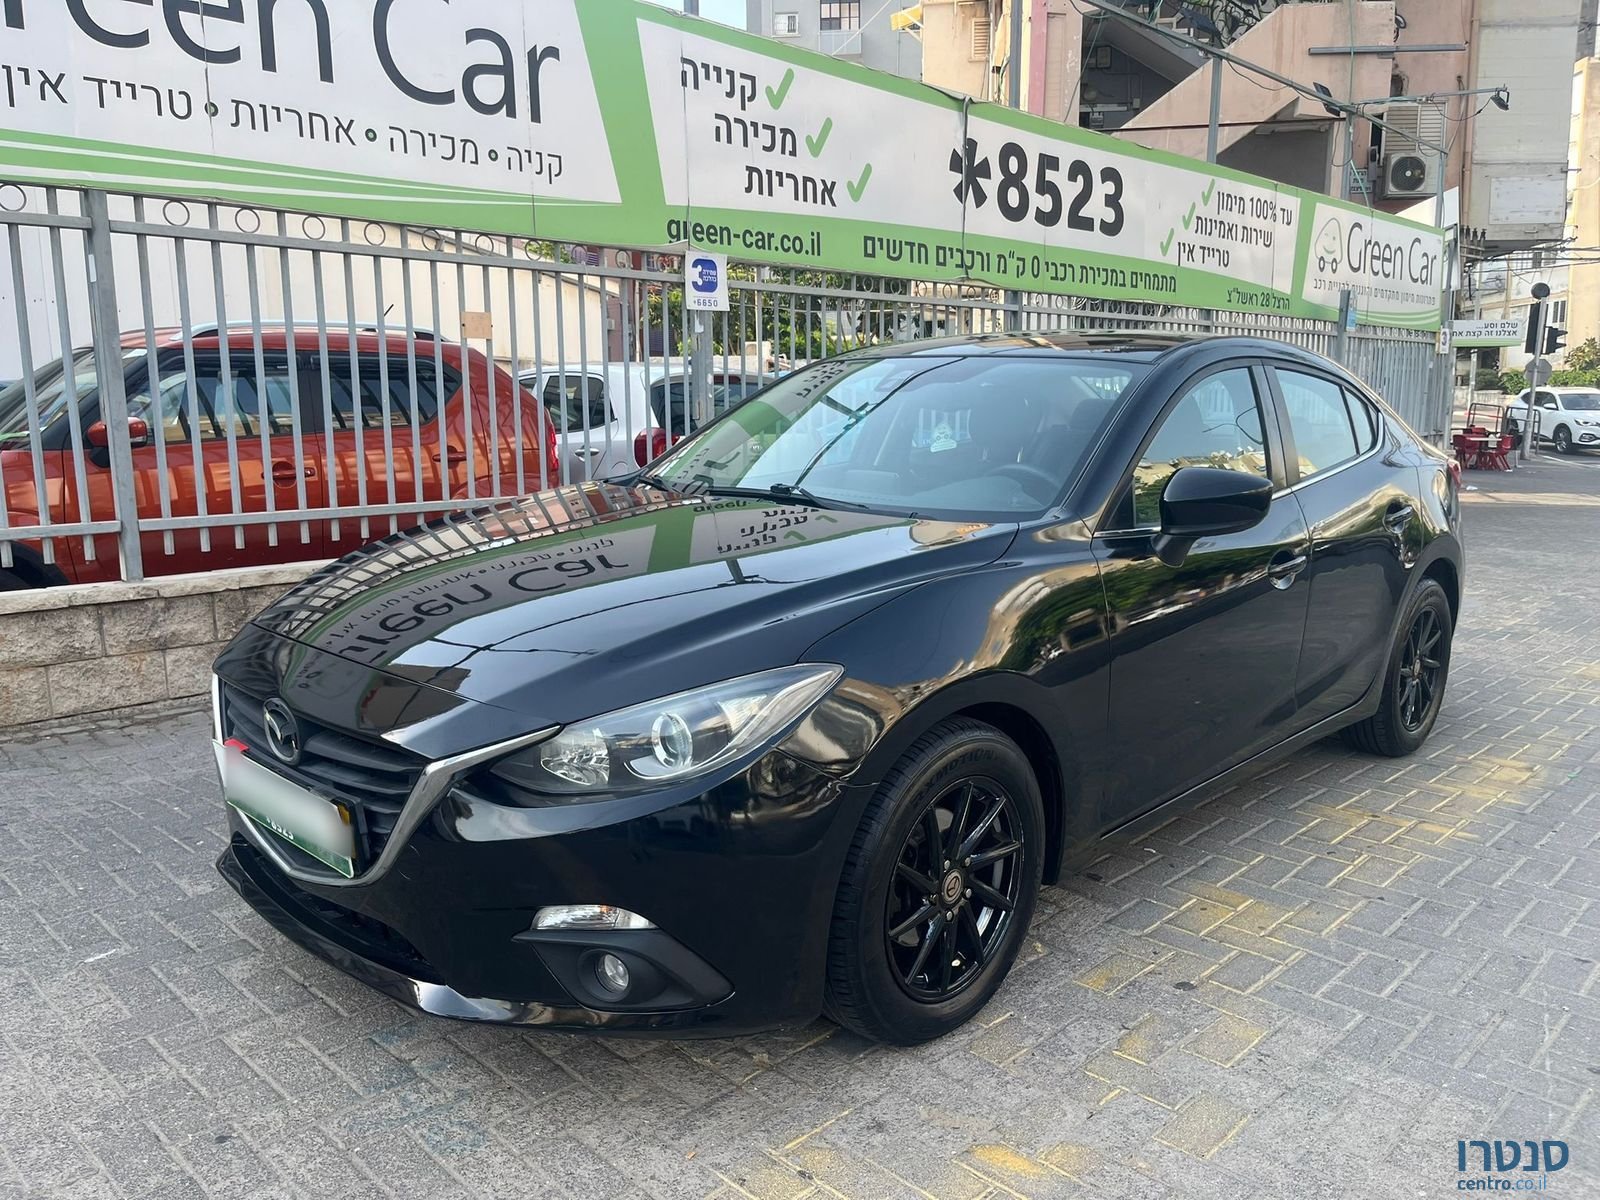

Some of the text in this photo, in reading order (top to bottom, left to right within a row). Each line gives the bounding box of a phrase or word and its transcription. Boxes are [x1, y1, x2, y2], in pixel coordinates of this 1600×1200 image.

[372, 0, 560, 124] Car
[680, 56, 757, 111] קנייה
[2, 63, 564, 185] קניה מכירה אחריות טרייד אין
[714, 112, 798, 158] מכירה
[744, 165, 838, 208] אחריות
[1216, 190, 1293, 227] עד 100% מימון
[666, 218, 821, 257] green-car.co.il
[1195, 214, 1273, 249] שירות ואמינות
[863, 235, 929, 266] חדשים
[935, 244, 991, 273] ורכבים
[1031, 254, 1040, 278] 0
[1177, 240, 1230, 268] טרייד אין
[1347, 222, 1437, 286] Green Car
[1044, 259, 1075, 284] רכבי
[1079, 263, 1127, 289] במכירת
[1130, 270, 1177, 294] מתמחים
[1260, 291, 1271, 306] 28
[1271, 292, 1290, 311] הרצל
